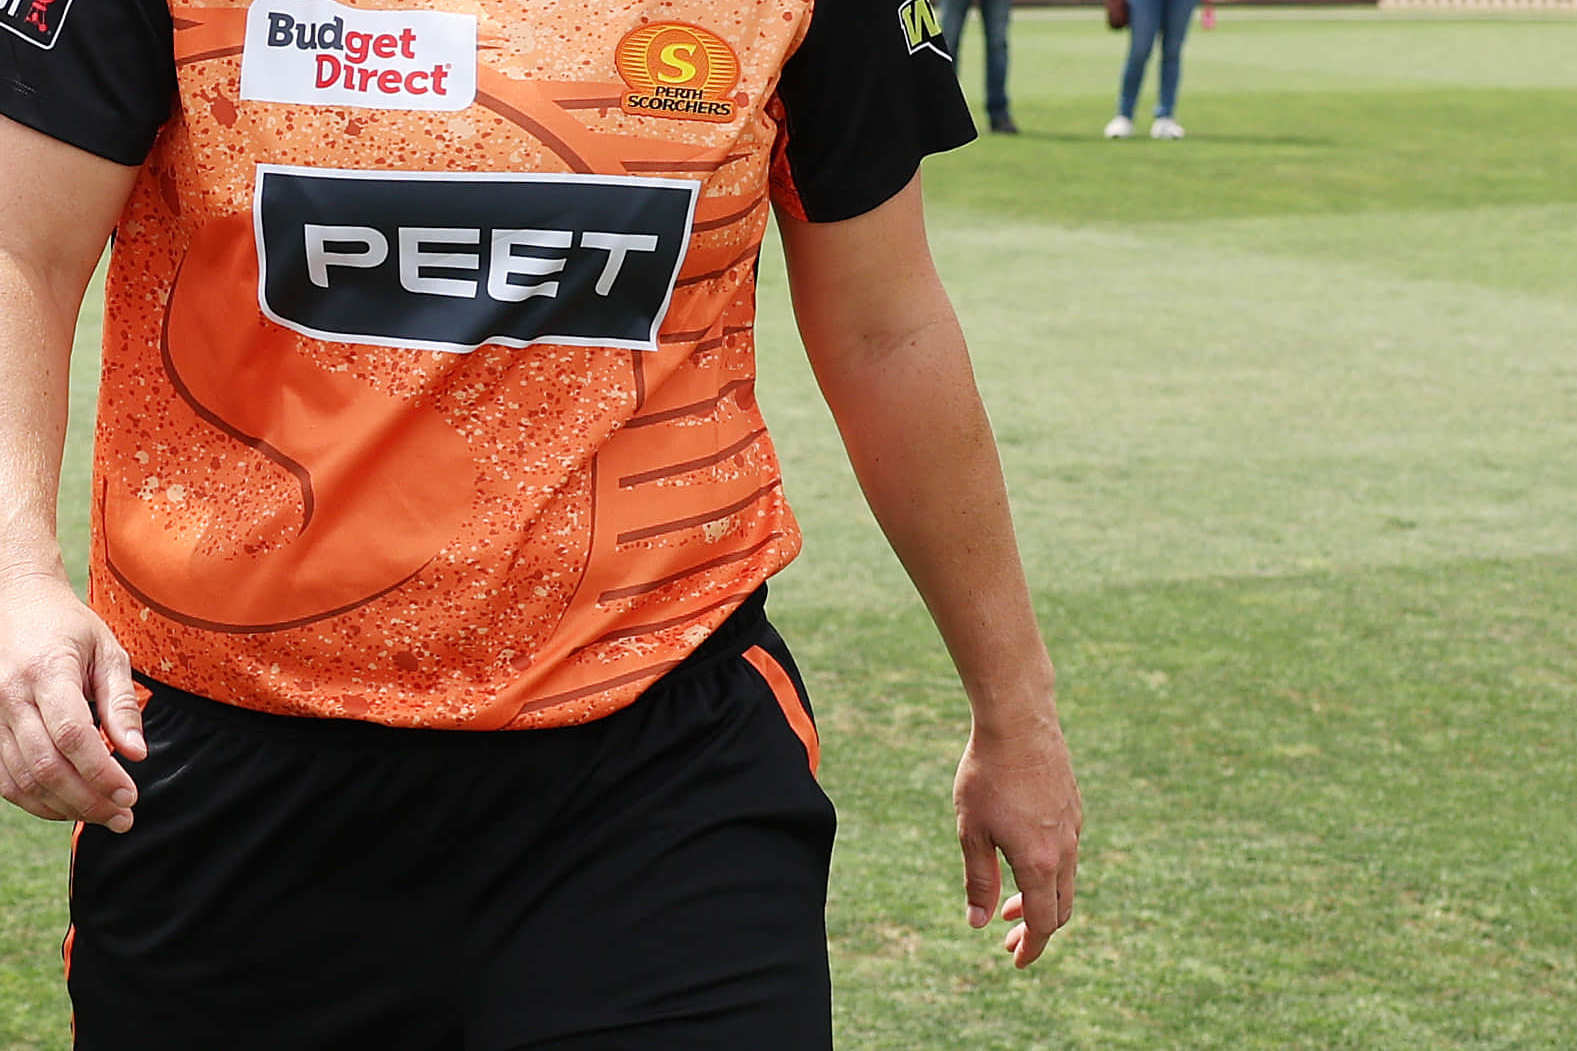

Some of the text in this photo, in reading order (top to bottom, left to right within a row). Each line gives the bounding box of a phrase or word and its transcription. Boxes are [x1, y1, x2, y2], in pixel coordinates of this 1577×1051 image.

[266, 11, 417, 60] Budget
[315, 55, 449, 96] Direct
[657, 43, 697, 84] S
[627, 95, 732, 116] SCORCHERS
[655, 86, 704, 101] PERTH
[303, 223, 659, 303] PEET
